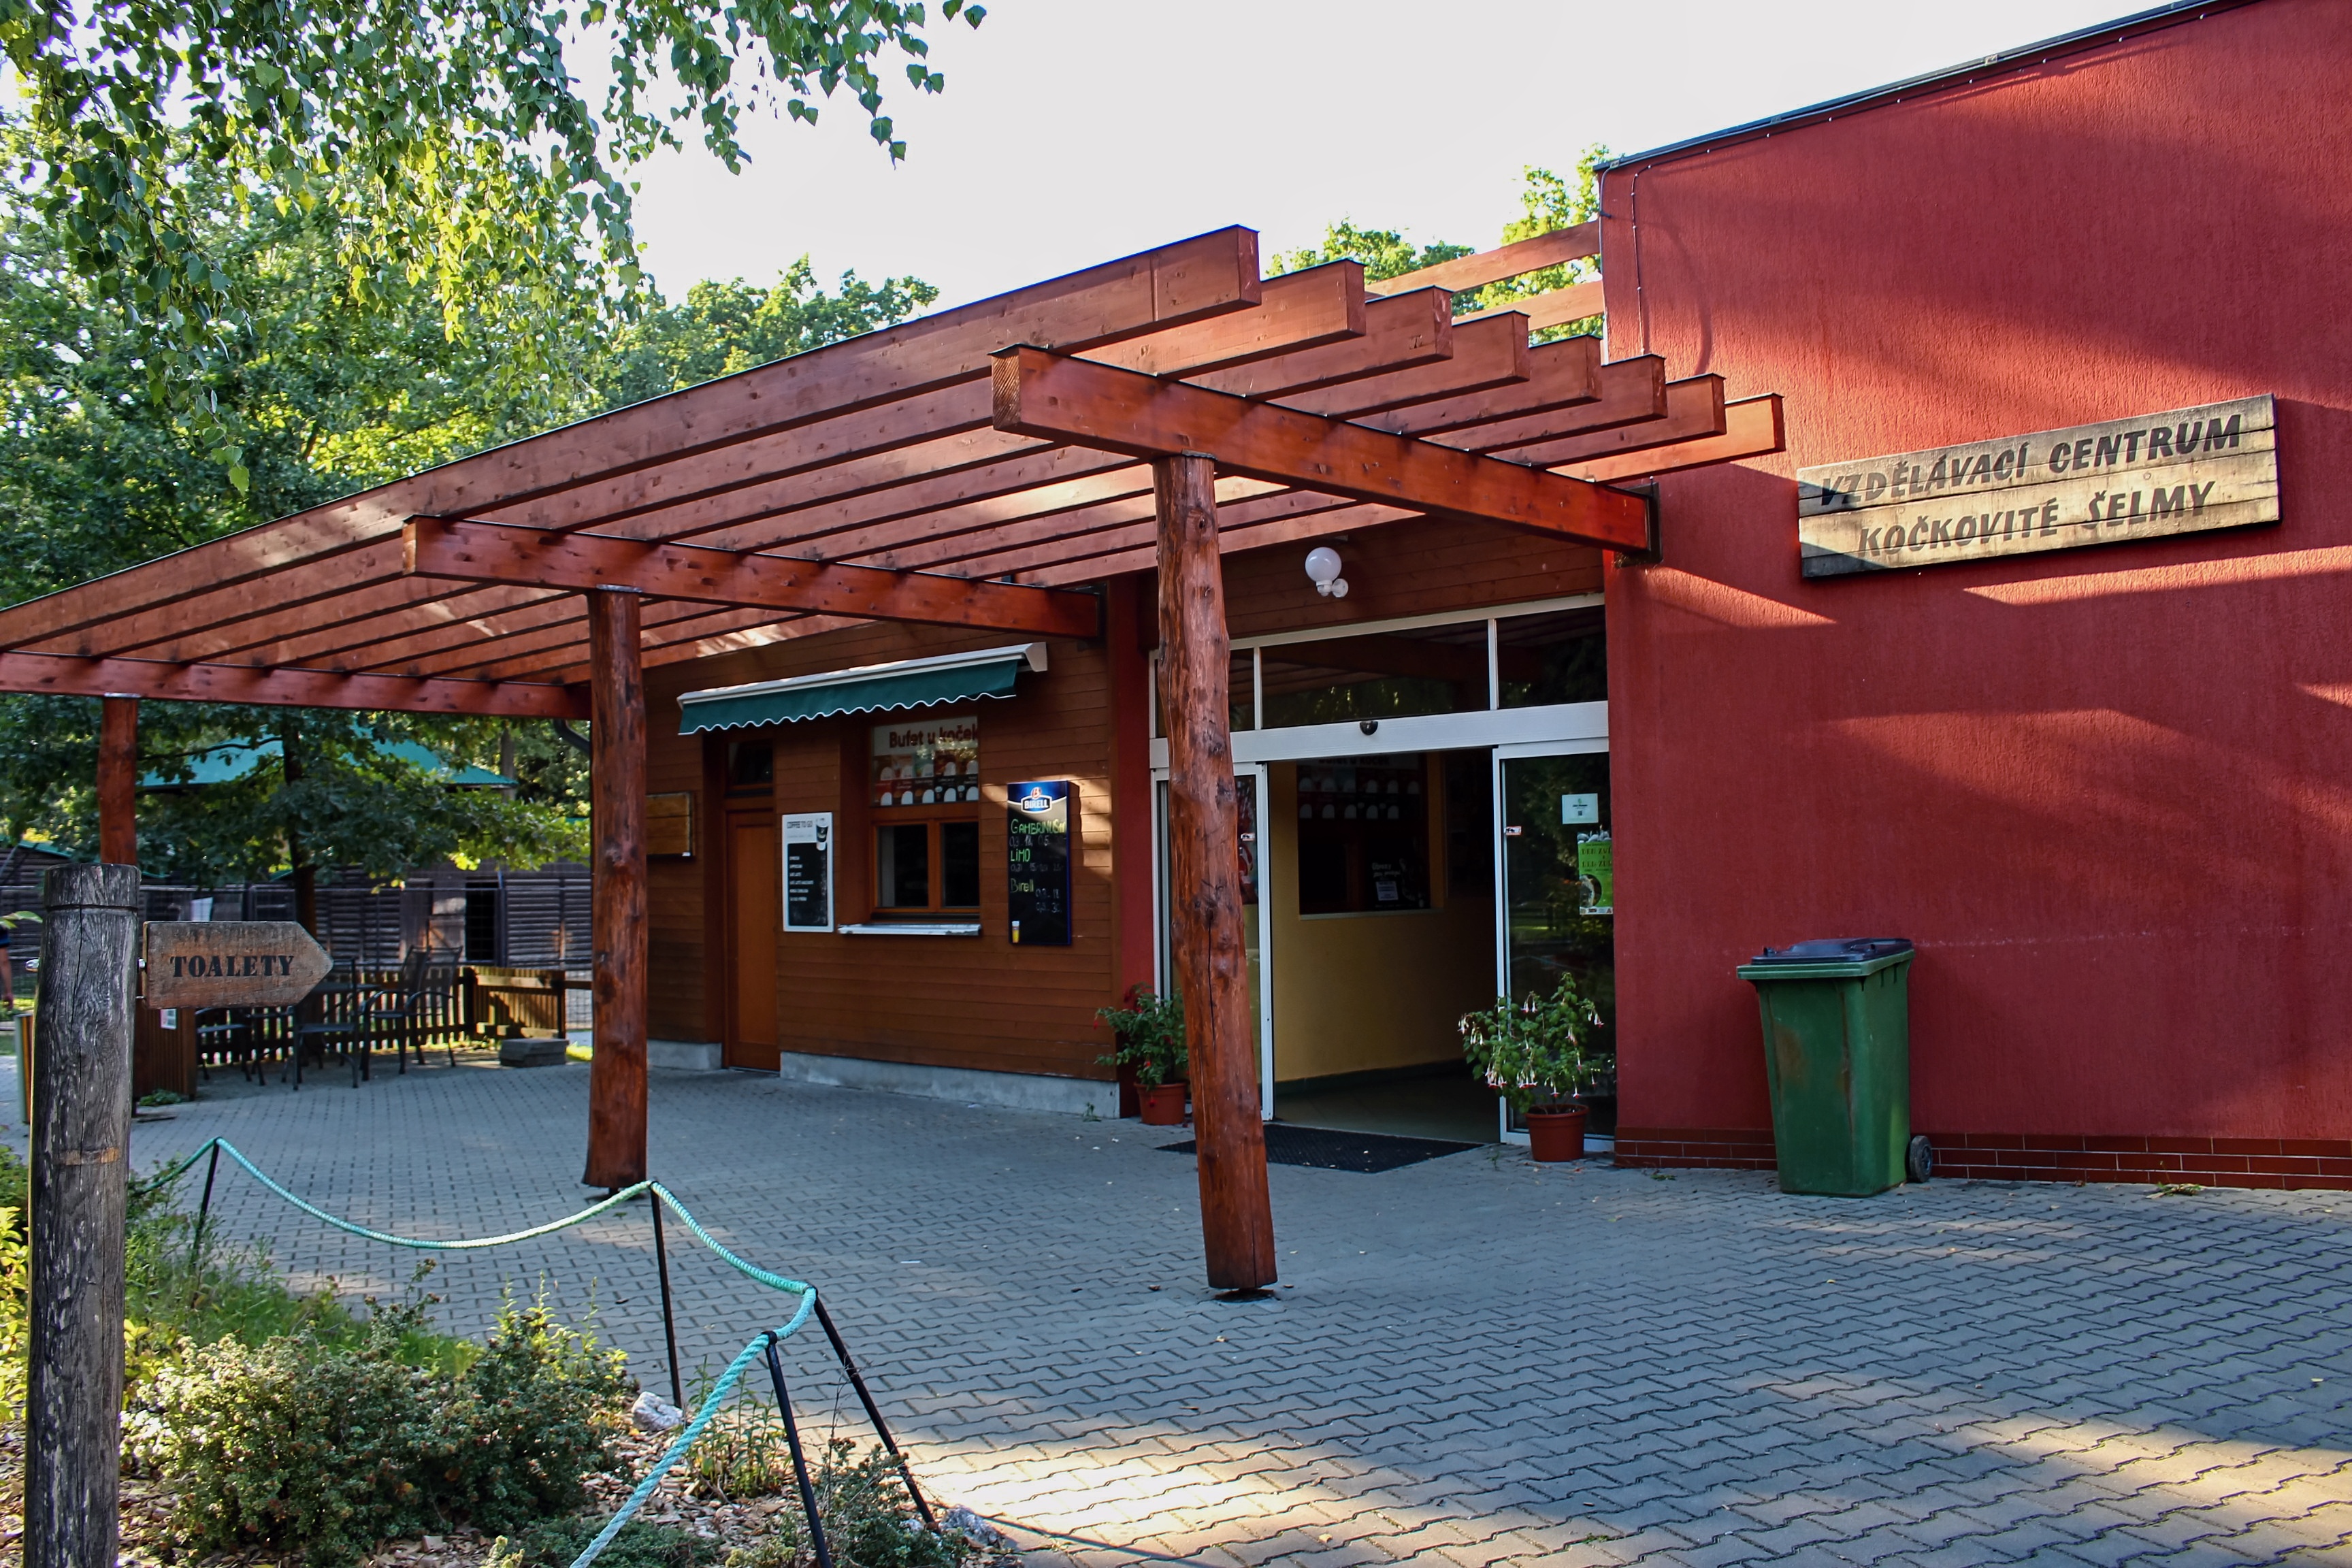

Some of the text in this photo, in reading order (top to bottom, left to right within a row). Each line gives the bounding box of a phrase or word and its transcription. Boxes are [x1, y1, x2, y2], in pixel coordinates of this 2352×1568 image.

[1820, 414, 2242, 506] VZDĚLÁVACÍ CENTRUM
[1858, 480, 2216, 557] KOČKOVITÉ ŠELMY
[889, 730, 924, 749] Bufet
[928, 732, 936, 745] u
[1024, 799, 1049, 809] BIRELL
[169, 955, 295, 978] TOALETY
